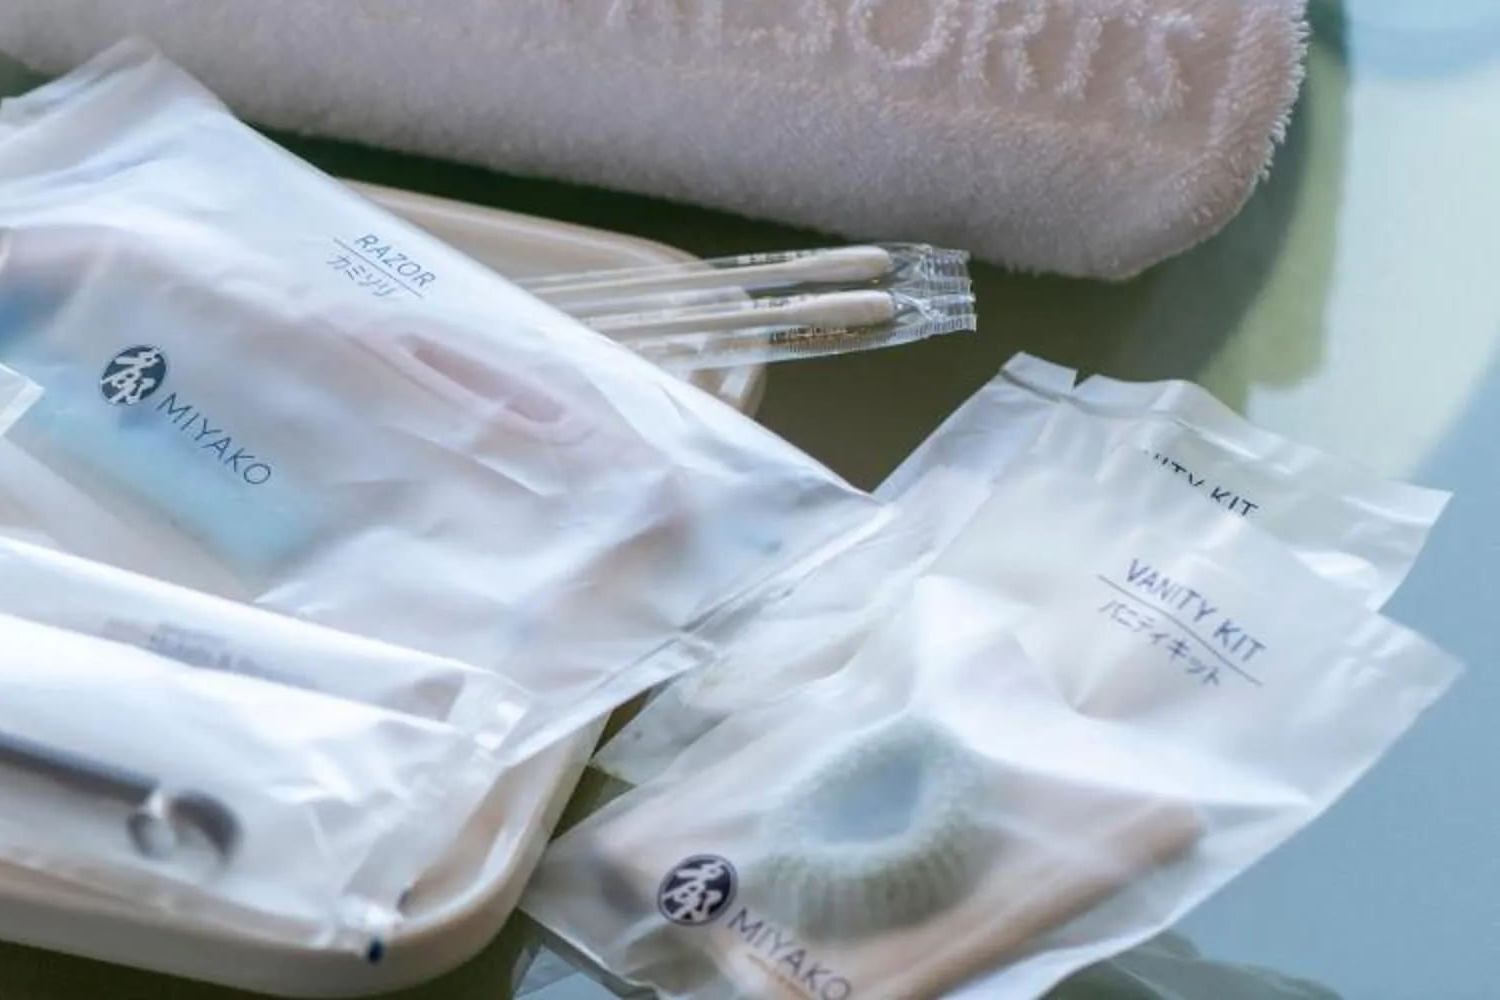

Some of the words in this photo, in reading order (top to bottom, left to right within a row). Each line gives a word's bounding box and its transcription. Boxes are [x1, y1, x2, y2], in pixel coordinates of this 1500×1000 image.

[354, 235, 437, 287] RAZOR
[156, 392, 271, 485] MIYAKO
[1210, 485, 1260, 517] KIT
[1126, 557, 1217, 623] VANITY
[1213, 618, 1267, 663] KIT
[727, 906, 852, 1000] MIYAKO
